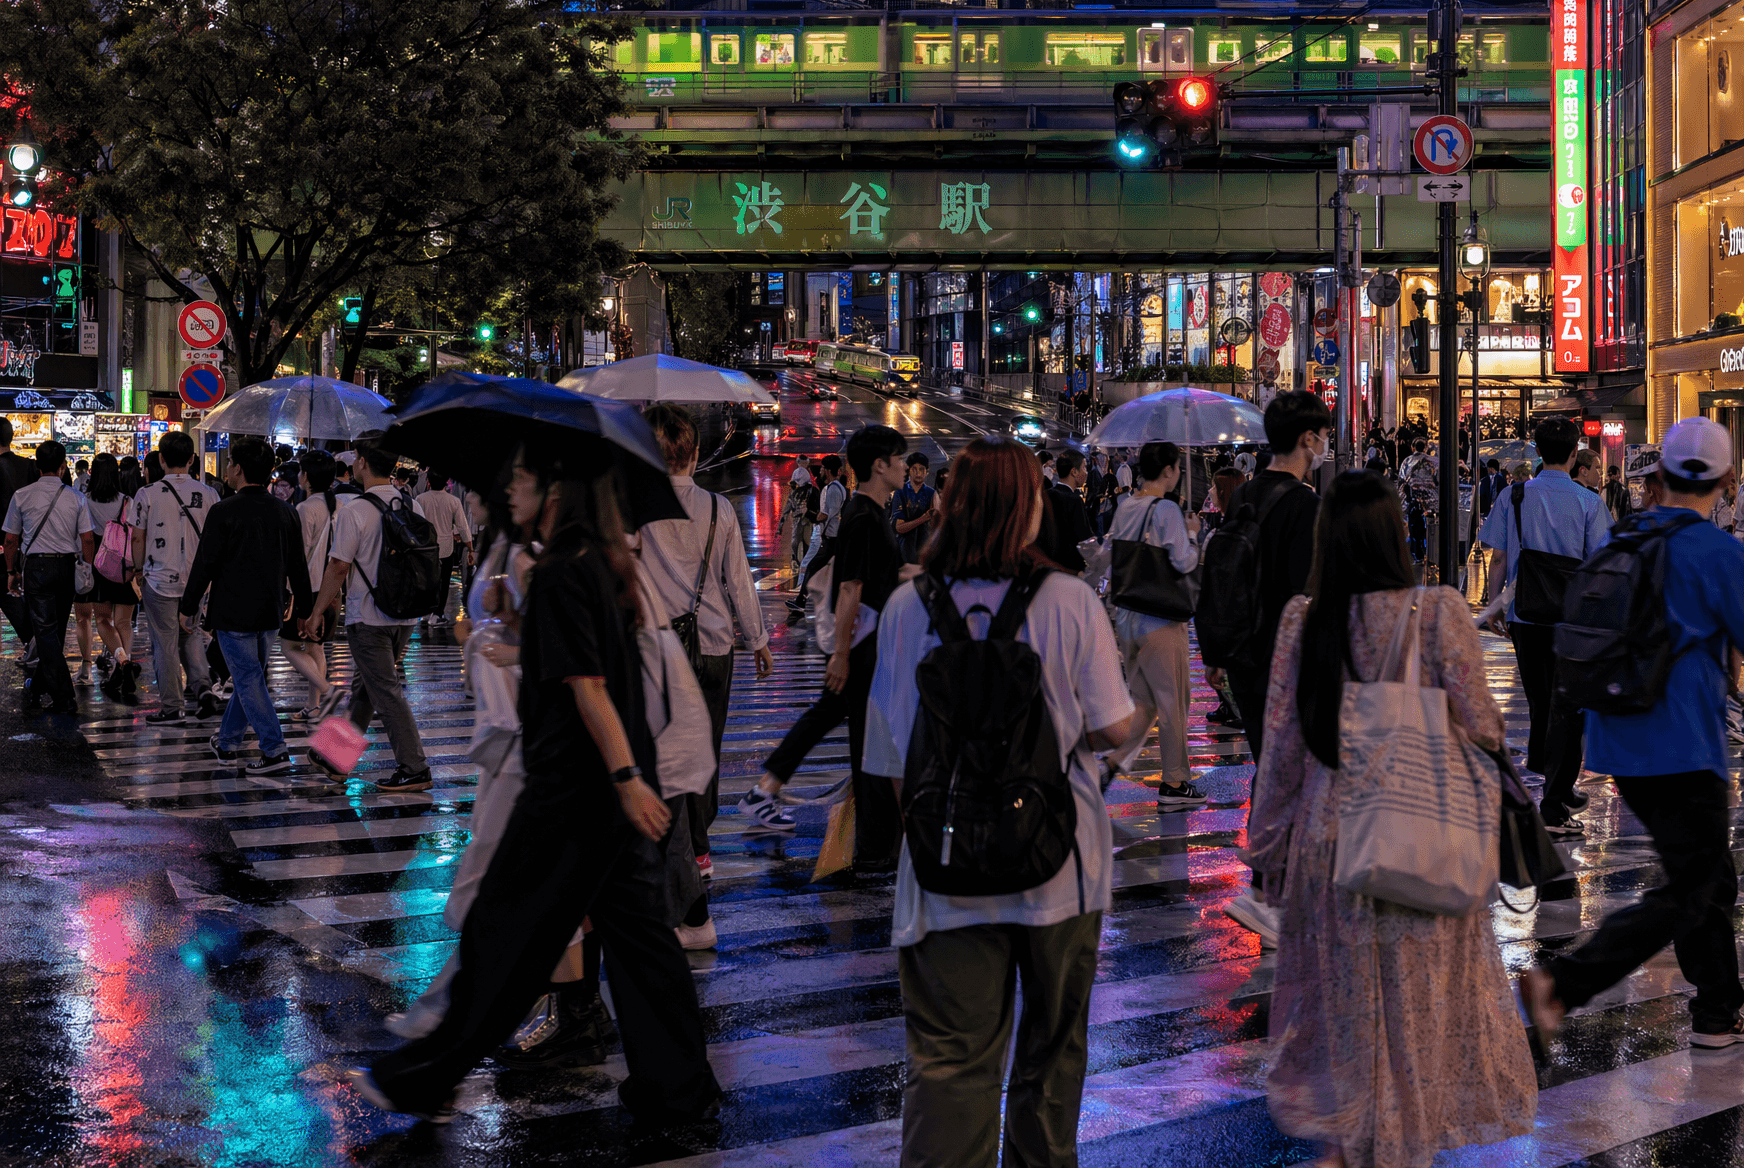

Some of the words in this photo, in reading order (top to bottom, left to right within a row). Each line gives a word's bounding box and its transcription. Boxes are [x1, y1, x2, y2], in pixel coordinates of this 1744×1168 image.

[651, 196, 693, 221] JR
[731, 180, 994, 235] 渋谷駅
[1560, 274, 1583, 340] アコム
